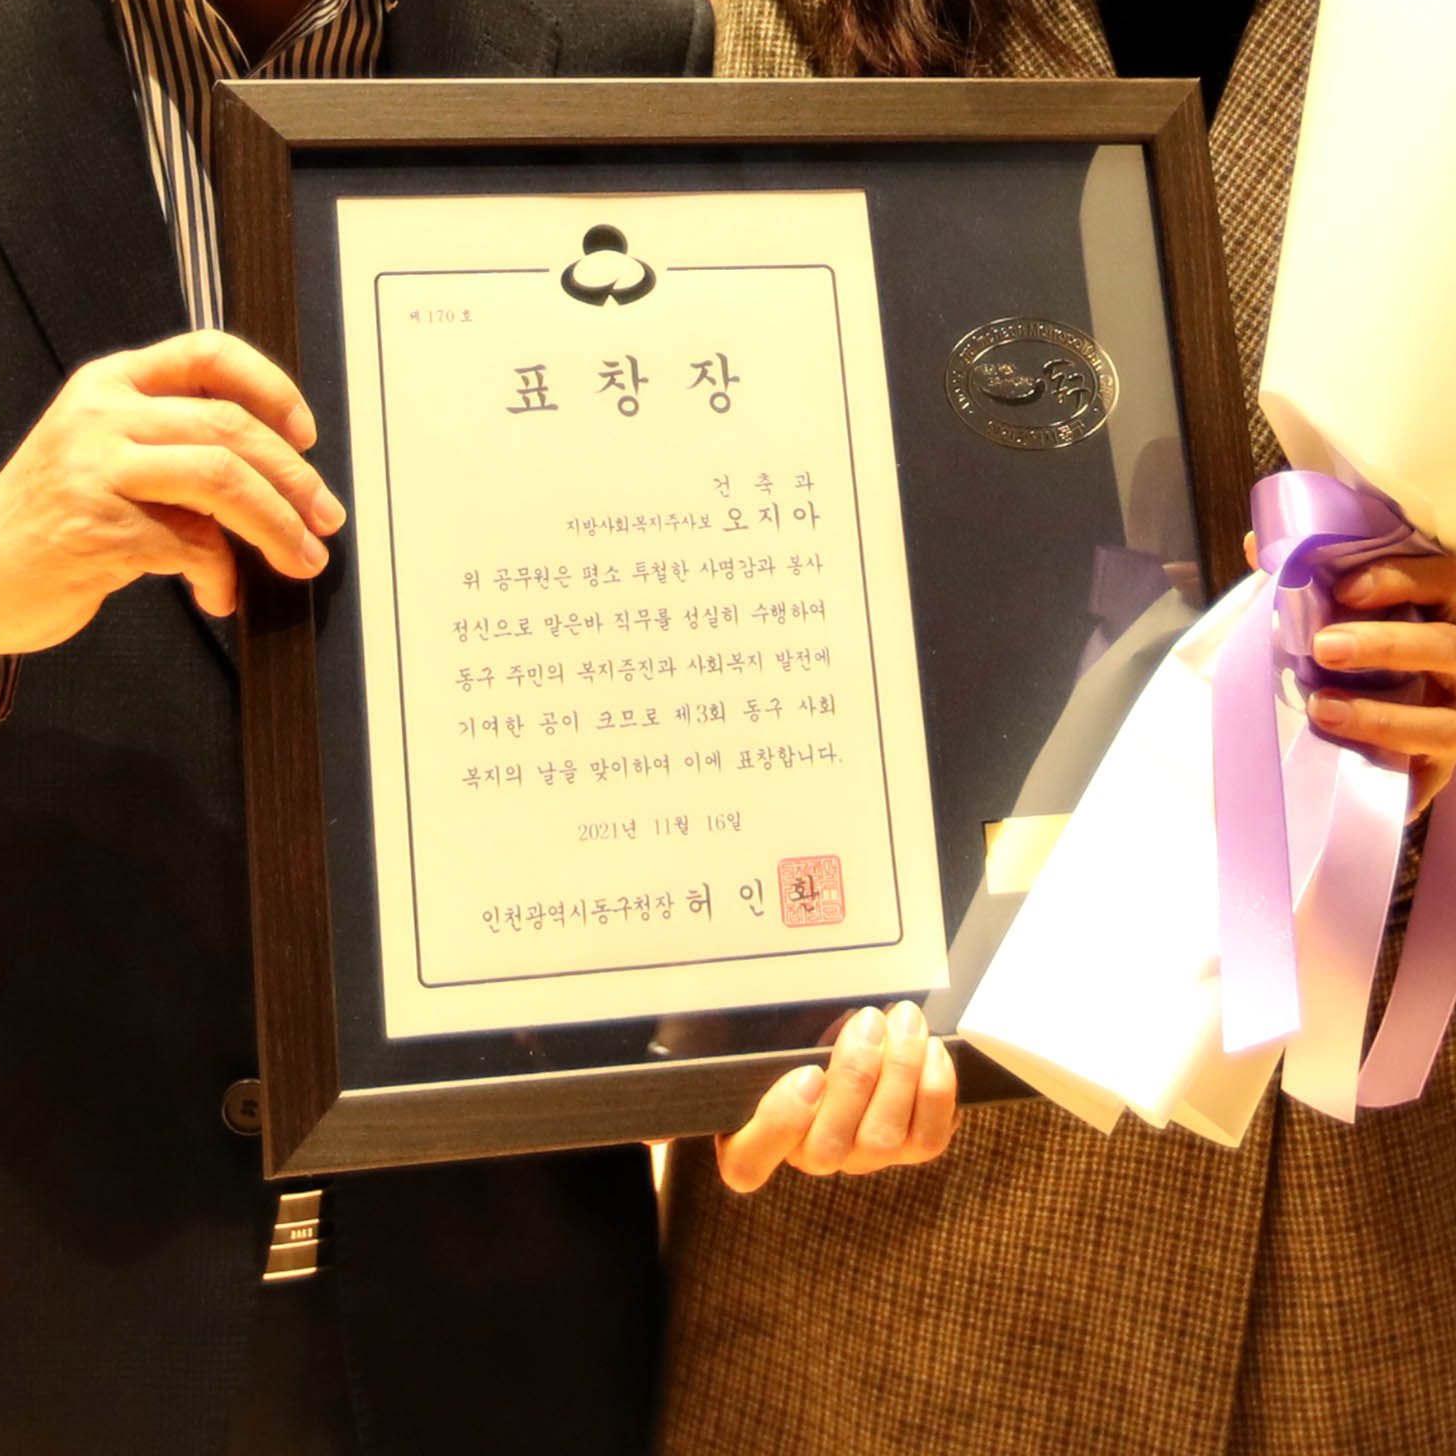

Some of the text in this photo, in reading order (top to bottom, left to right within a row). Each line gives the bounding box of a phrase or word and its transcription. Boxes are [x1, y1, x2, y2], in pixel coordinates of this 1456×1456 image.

[566, 512, 713, 537] 지방사회복지주사보
[462, 552, 824, 593] 위 공무원은 평소 투철한 사명감과 봉사
[453, 599, 826, 644] 정신으로 맡은바 직무를 성실히 수행하여
[455, 646, 831, 693] 동구 주민의 복지증진과 사회복지 발전에
[458, 693, 836, 740] 기여한 공이 크므로 제3회 동구 사회
[461, 741, 843, 790] 복지의 날을 맞이하여 이에 표창합니다.
[577, 810, 742, 842] 2021년 11월 16일
[481, 891, 676, 935] 인천광역시동구청장
